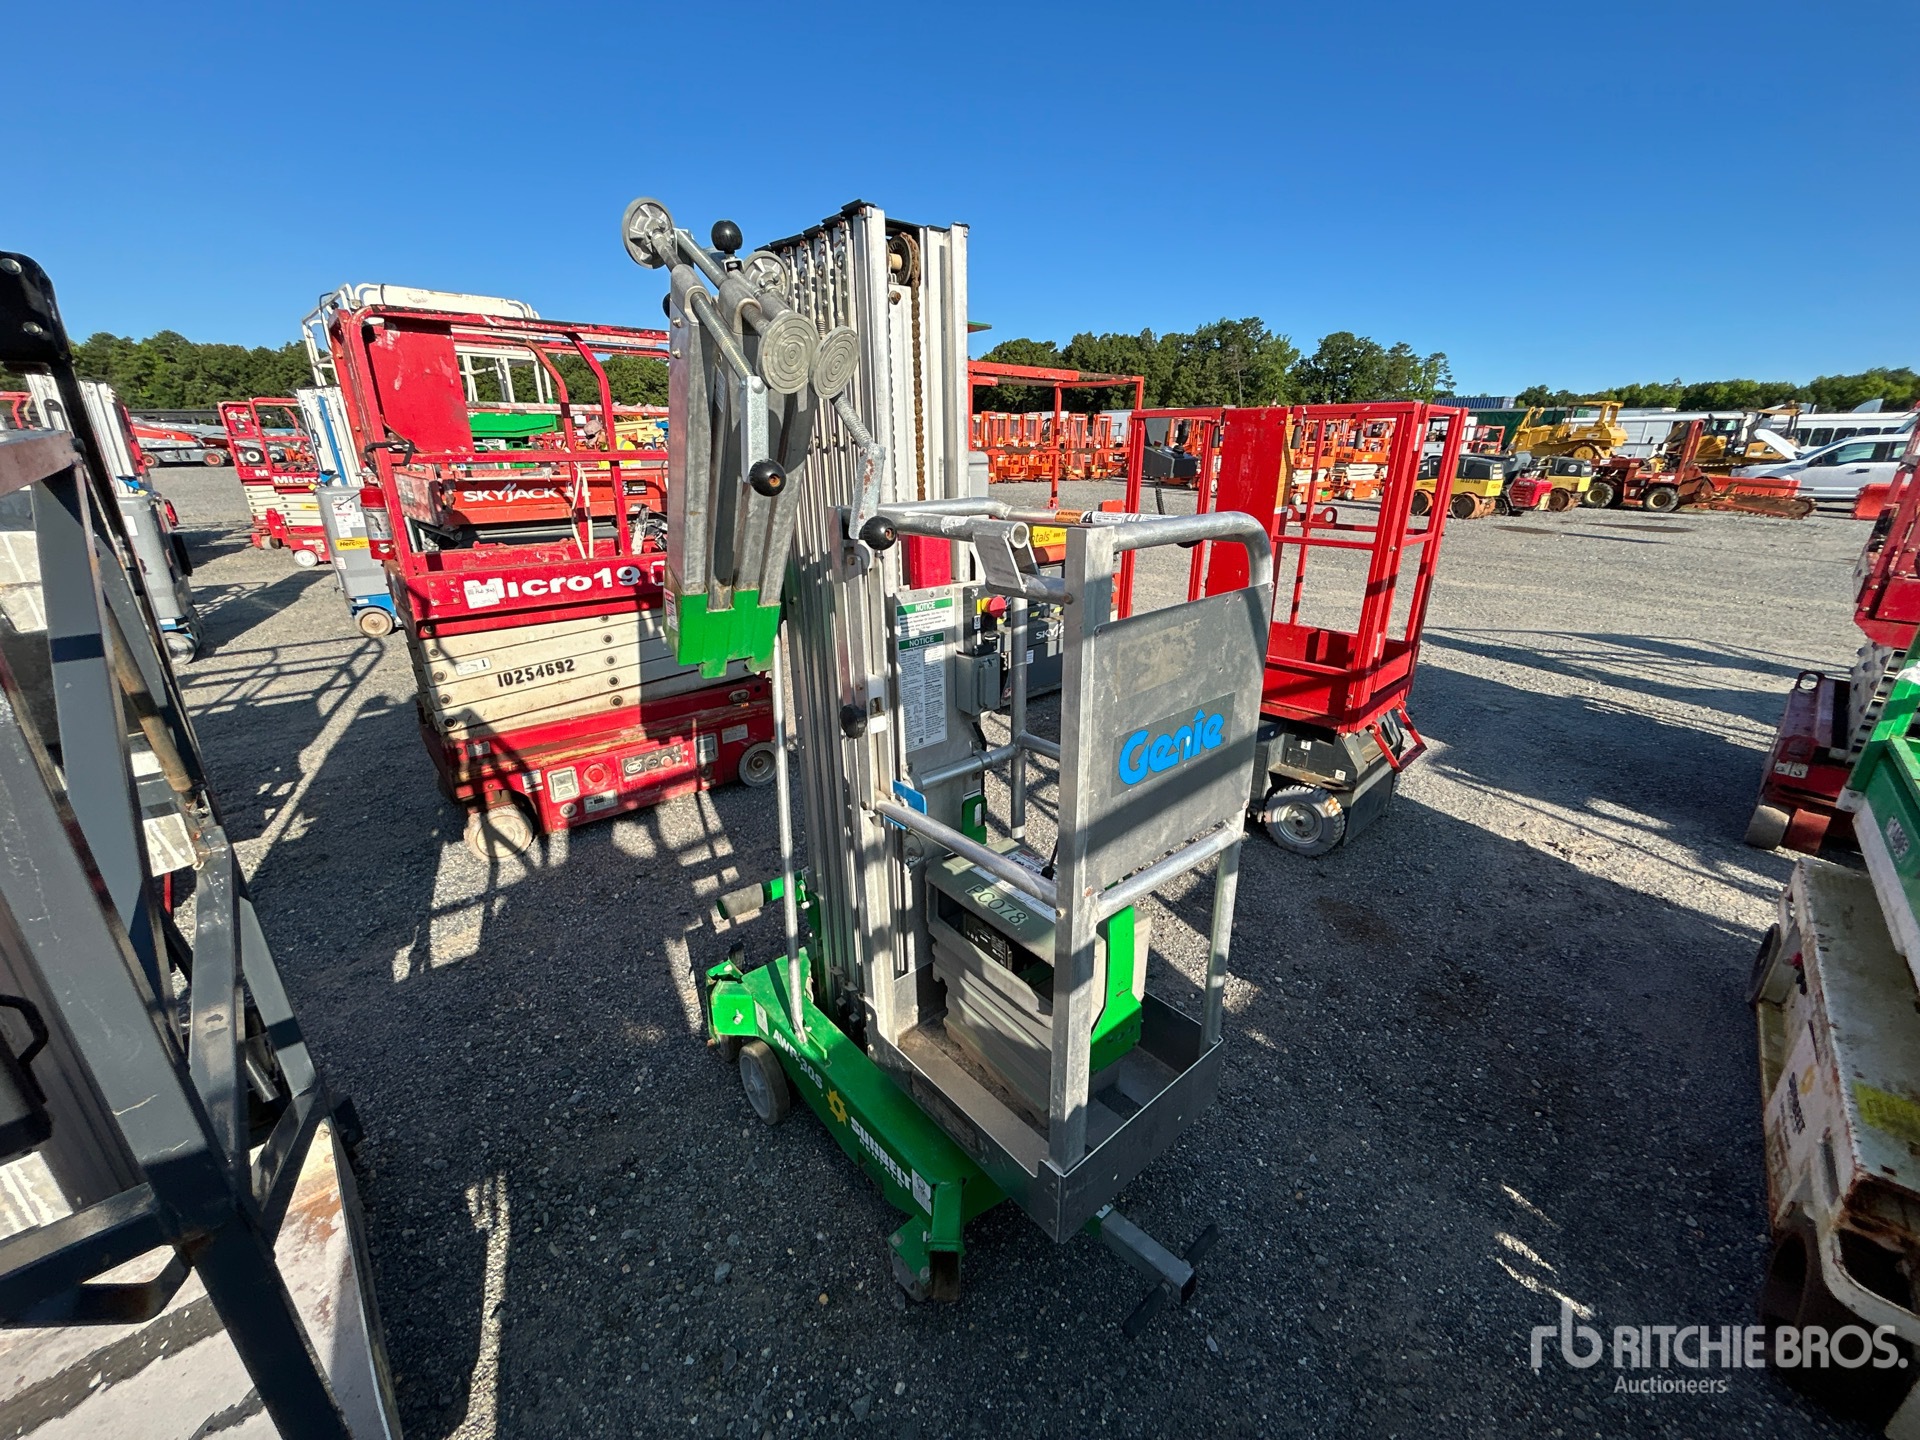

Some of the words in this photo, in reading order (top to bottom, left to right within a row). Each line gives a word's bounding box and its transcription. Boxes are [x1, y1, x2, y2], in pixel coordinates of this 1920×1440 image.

[463, 482, 559, 503] SKYJACK
[915, 600, 936, 613] NOTICE
[908, 635, 935, 648] NOTICE
[1118, 709, 1225, 786] Genie
[850, 1115, 912, 1191] SUNBELT
